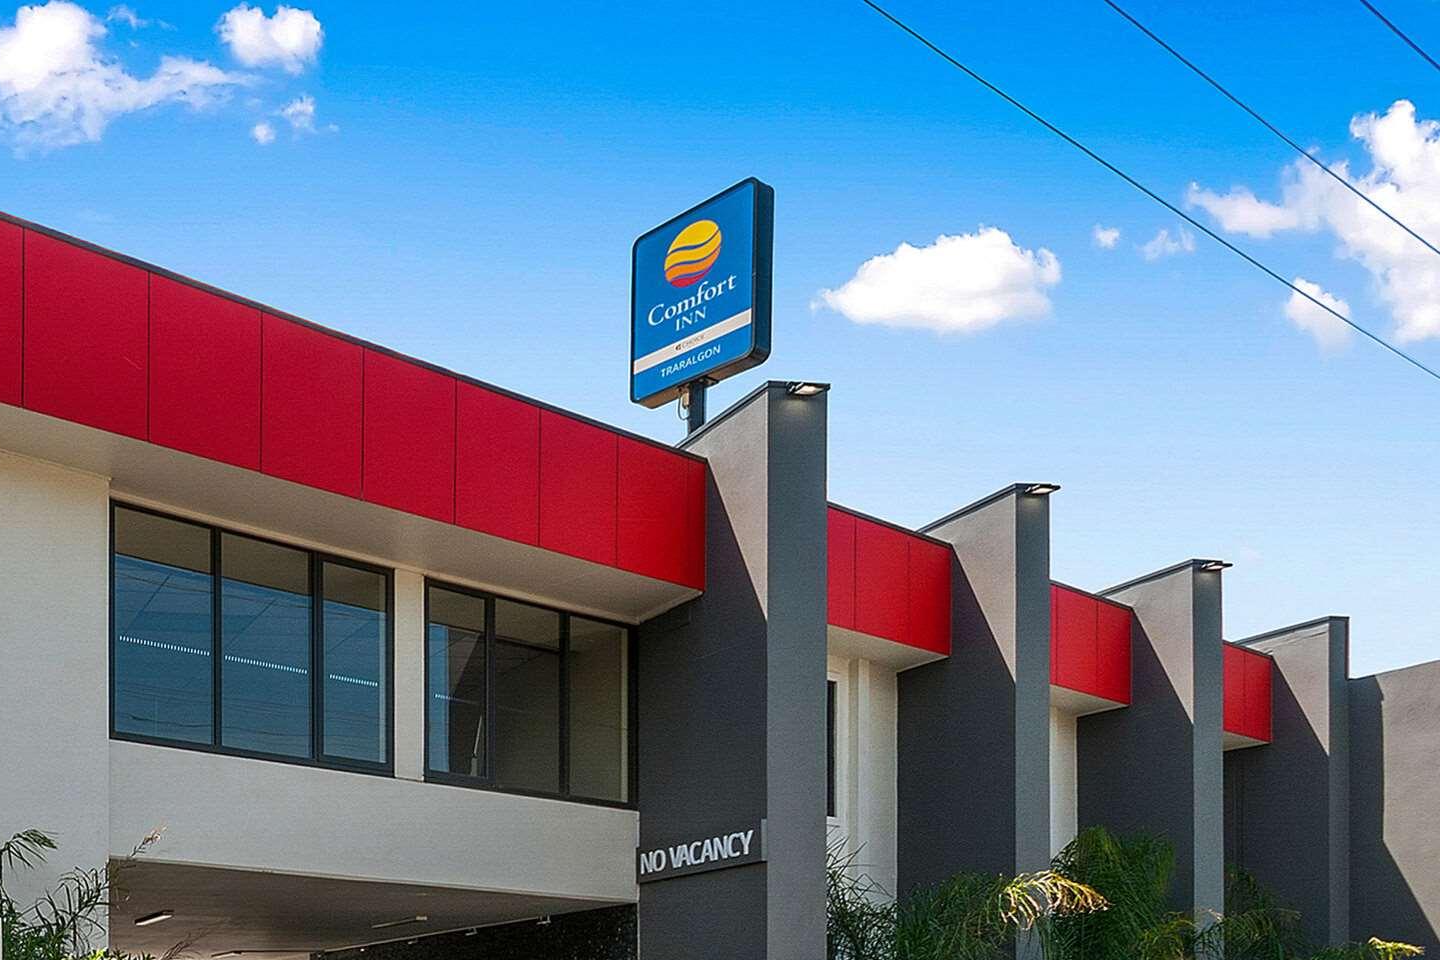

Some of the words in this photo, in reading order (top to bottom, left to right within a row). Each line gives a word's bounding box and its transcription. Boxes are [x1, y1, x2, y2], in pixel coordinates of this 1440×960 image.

[648, 274, 737, 326] Comfort
[675, 306, 707, 331] INN
[661, 344, 721, 377] TRARALGON
[640, 849, 666, 875] NO
[668, 829, 754, 869] VACANCY
